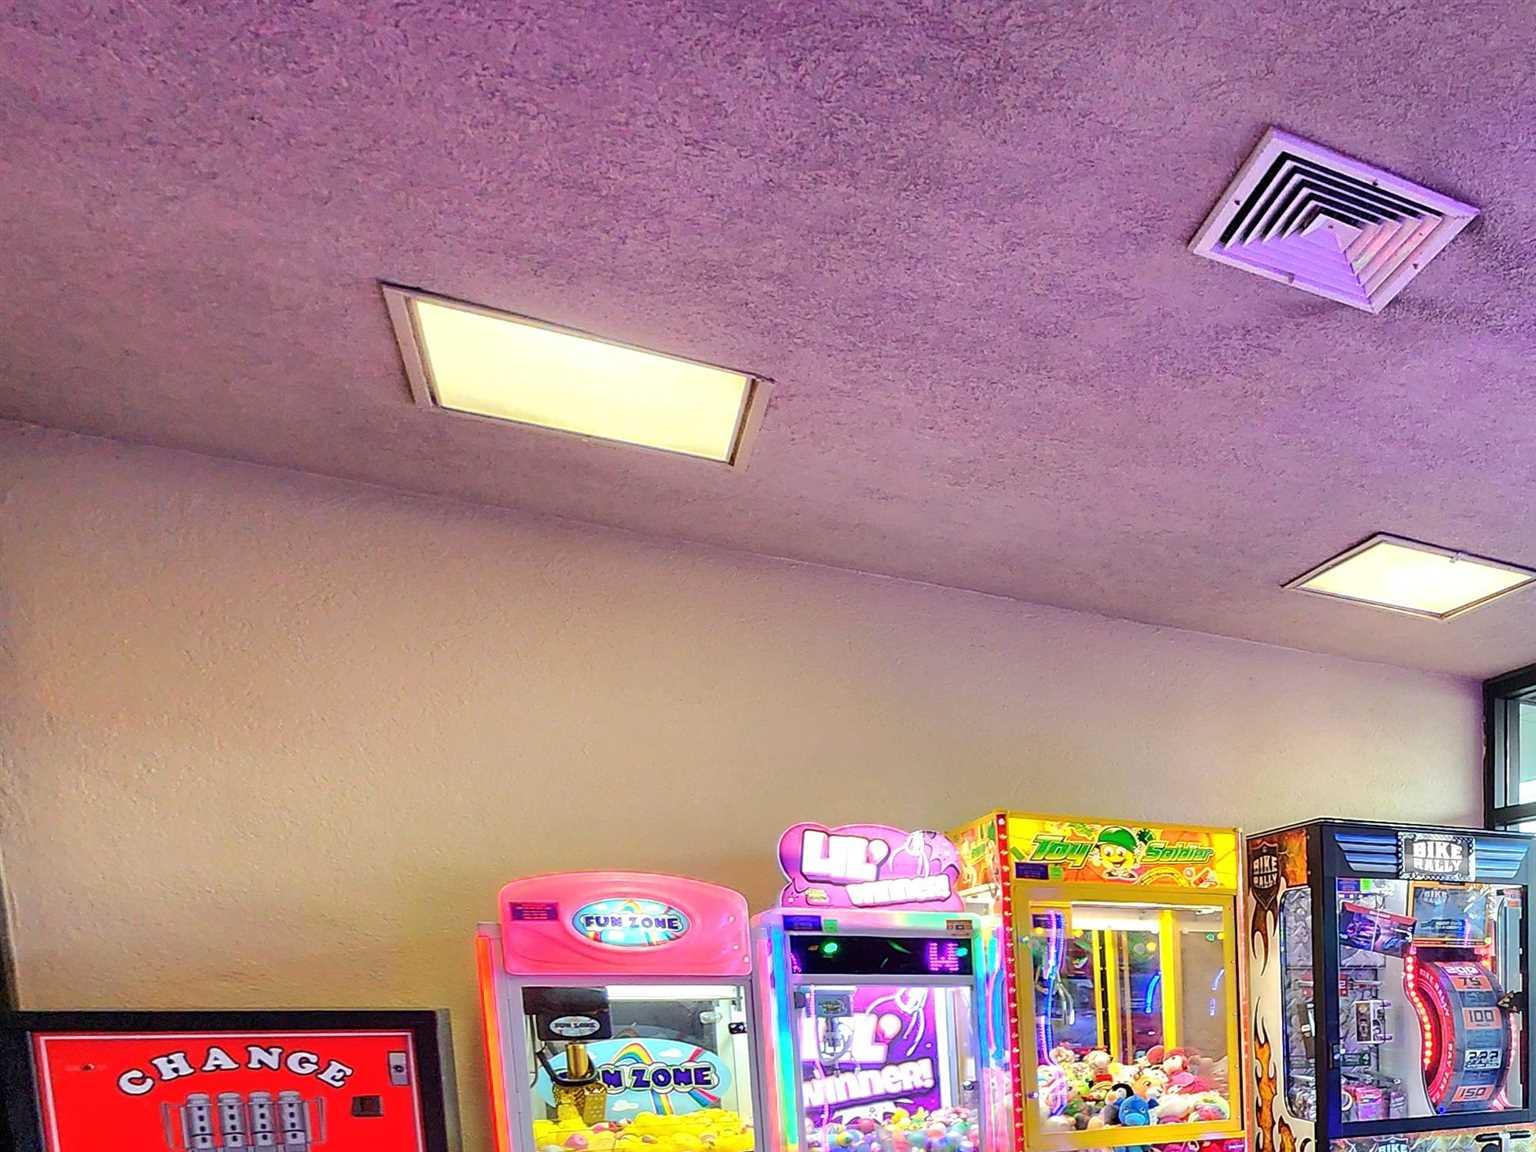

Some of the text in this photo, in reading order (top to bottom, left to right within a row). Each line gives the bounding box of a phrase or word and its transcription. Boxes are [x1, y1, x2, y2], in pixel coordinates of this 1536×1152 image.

[1031, 835, 1214, 868] Toy Soldier
[1413, 841, 1462, 859] BIKE
[1253, 855, 1278, 875] BIKE
[1413, 858, 1461, 872] RALLY
[1253, 872, 1278, 889] RALLY
[584, 916, 680, 930] FUN ZONE
[1469, 1010, 1494, 1023] 100
[117, 1046, 354, 1096] CHANGE
[632, 1067, 712, 1087] ZONE
